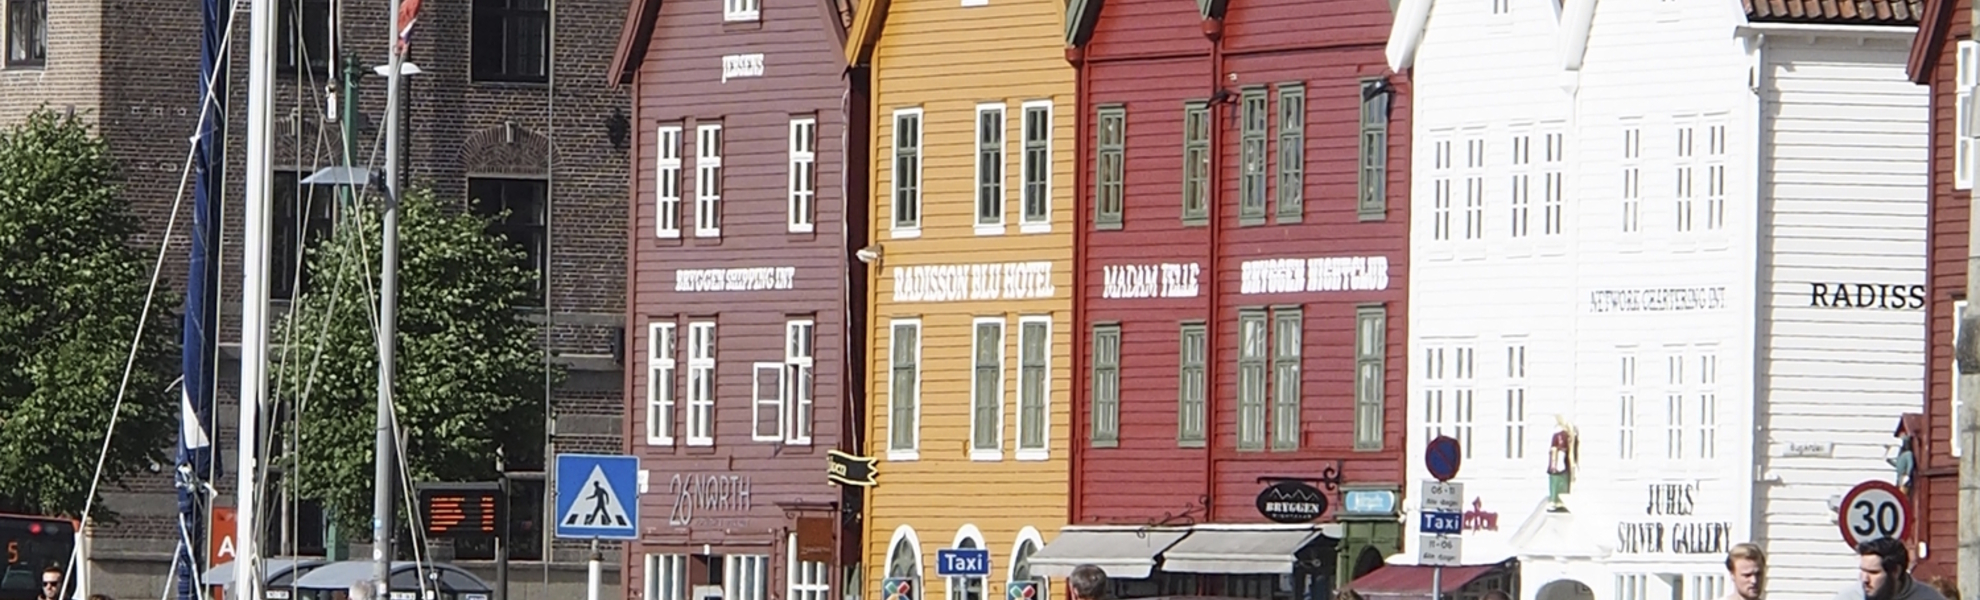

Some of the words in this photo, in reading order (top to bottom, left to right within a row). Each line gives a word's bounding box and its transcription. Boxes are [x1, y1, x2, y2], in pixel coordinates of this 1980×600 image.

[675, 269, 726, 291] BRYGGEN
[726, 267, 775, 290] SHIPPING
[892, 265, 970, 302] RADISSON
[970, 262, 1003, 300] BLU
[1002, 261, 1056, 299] HOTEL
[1102, 264, 1159, 299] MADAM
[1159, 262, 1200, 298] FELLE
[1240, 258, 1306, 294] BRYGGEN
[1306, 256, 1390, 291] NIGHTCLUB
[1589, 289, 1641, 313] NETWORK
[1641, 287, 1706, 311] CHARTERING
[1811, 282, 1926, 310] RADISS
[1265, 501, 1320, 514] BRYGGEN
[1424, 513, 1460, 530] Taxi
[1854, 500, 1899, 537] 30
[1616, 521, 1665, 554] SILVER
[1671, 521, 1732, 554] GALLERY
[944, 553, 983, 571] Taxi
